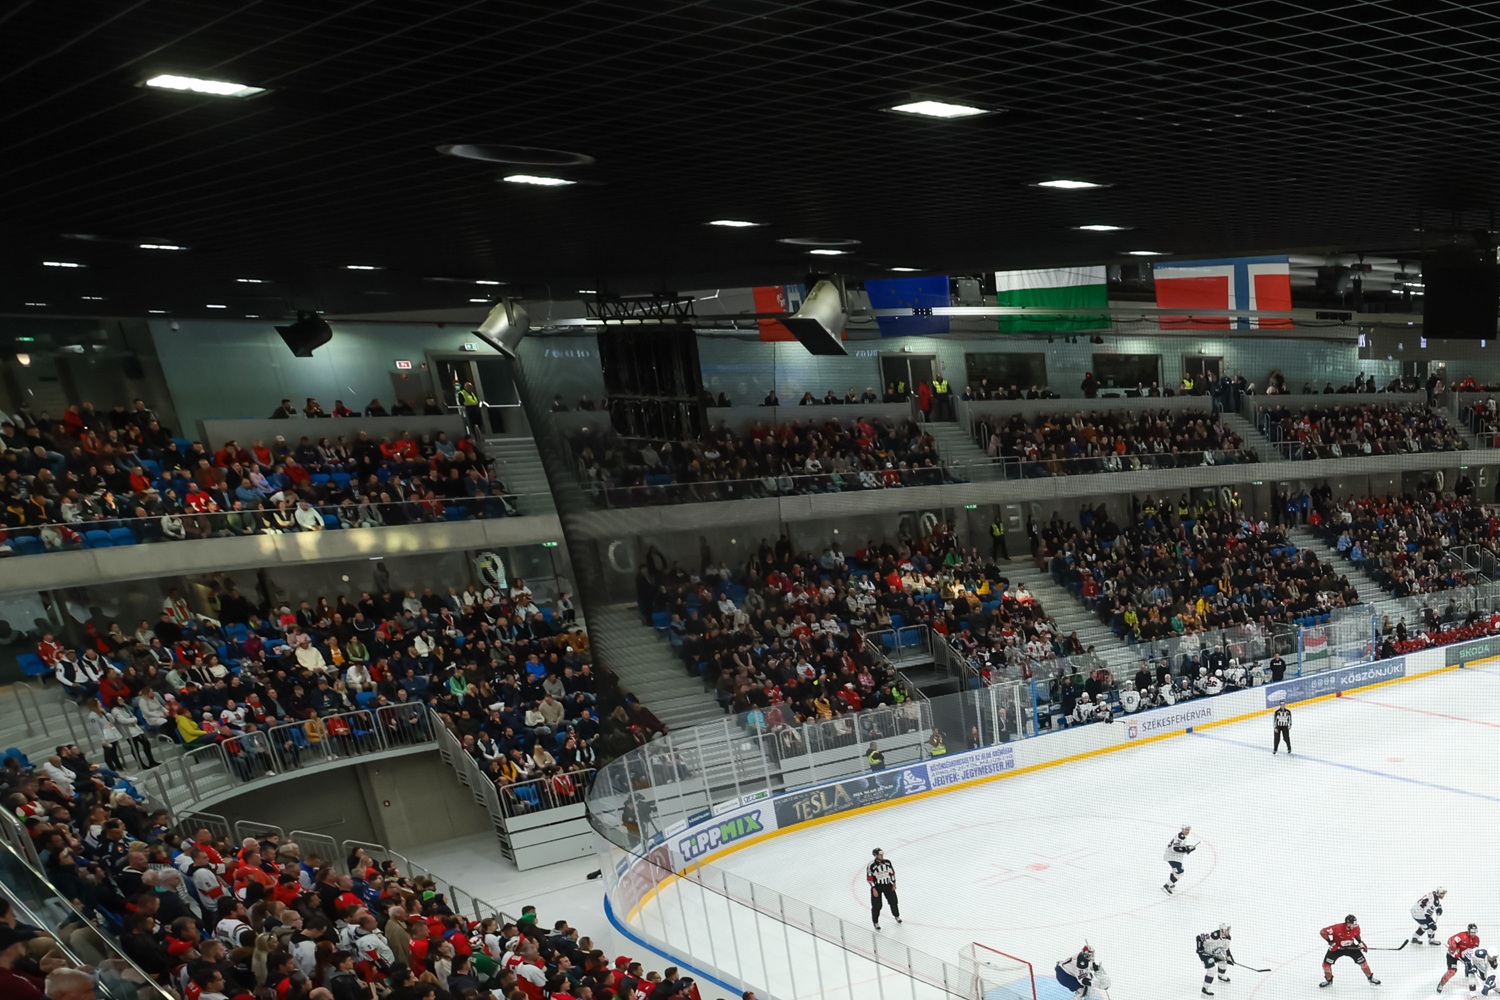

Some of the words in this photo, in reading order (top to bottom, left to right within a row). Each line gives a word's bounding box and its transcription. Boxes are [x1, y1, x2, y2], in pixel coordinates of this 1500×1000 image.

[1340, 663, 1403, 685] KÖSZÖNJÜK!
[1142, 708, 1212, 731] SZÉKESFEHÉRVÁR
[932, 772, 960, 787] JEGYEK:
[961, 759, 1014, 780] JEGYMESTER.HU
[793, 783, 852, 820] TESLA
